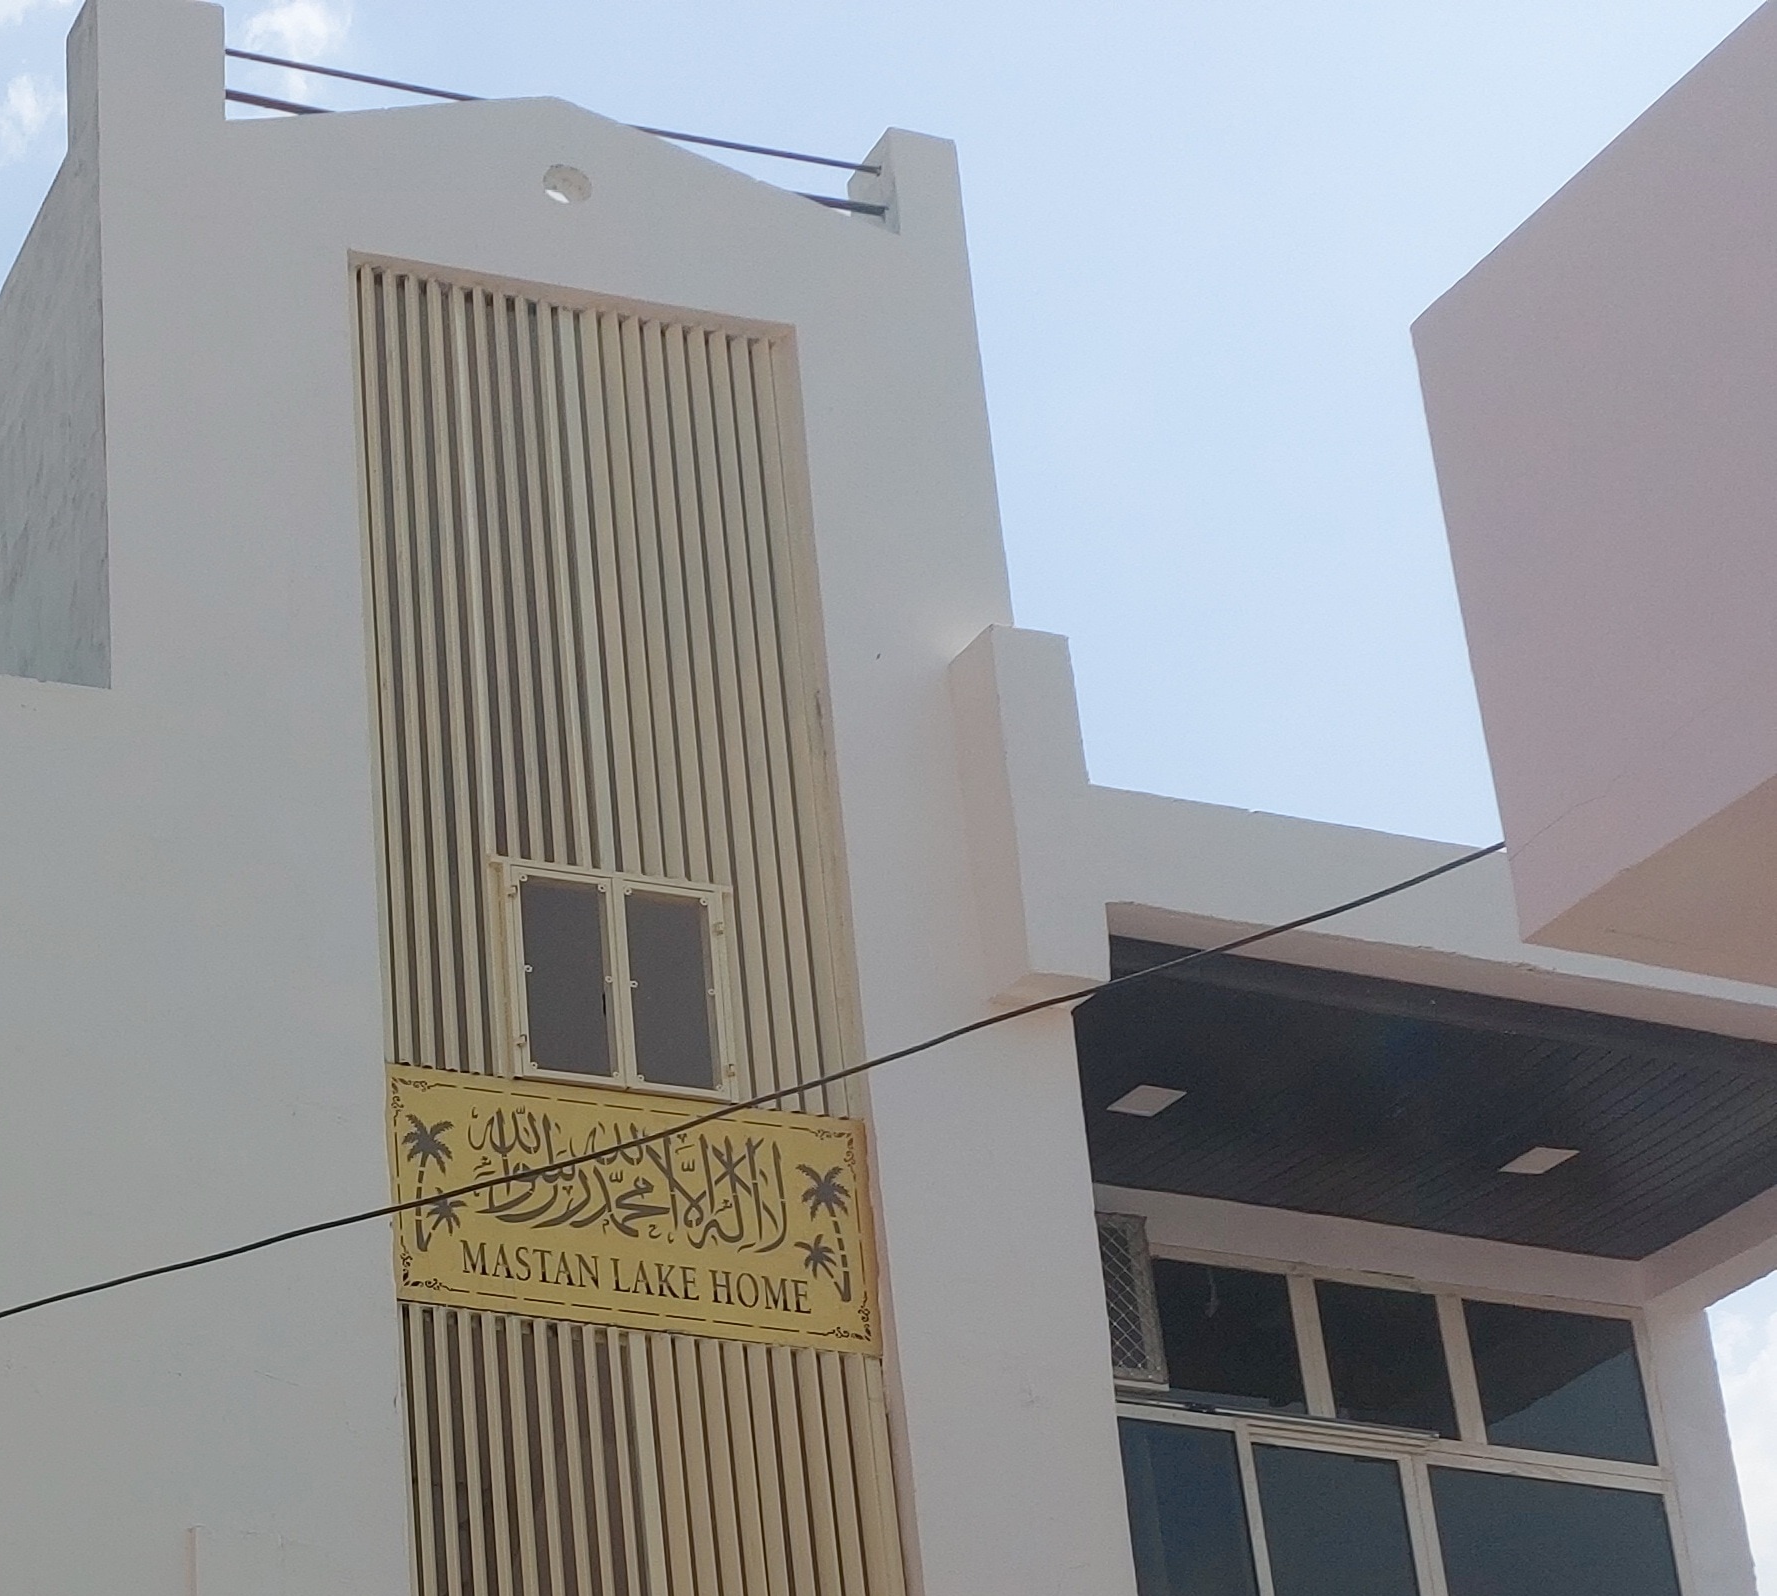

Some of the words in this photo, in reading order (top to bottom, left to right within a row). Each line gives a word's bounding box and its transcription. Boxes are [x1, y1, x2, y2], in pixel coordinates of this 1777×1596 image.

[459, 1239, 601, 1290] MASTAN
[610, 1256, 701, 1301] LAKE
[708, 1268, 813, 1315] HOME
